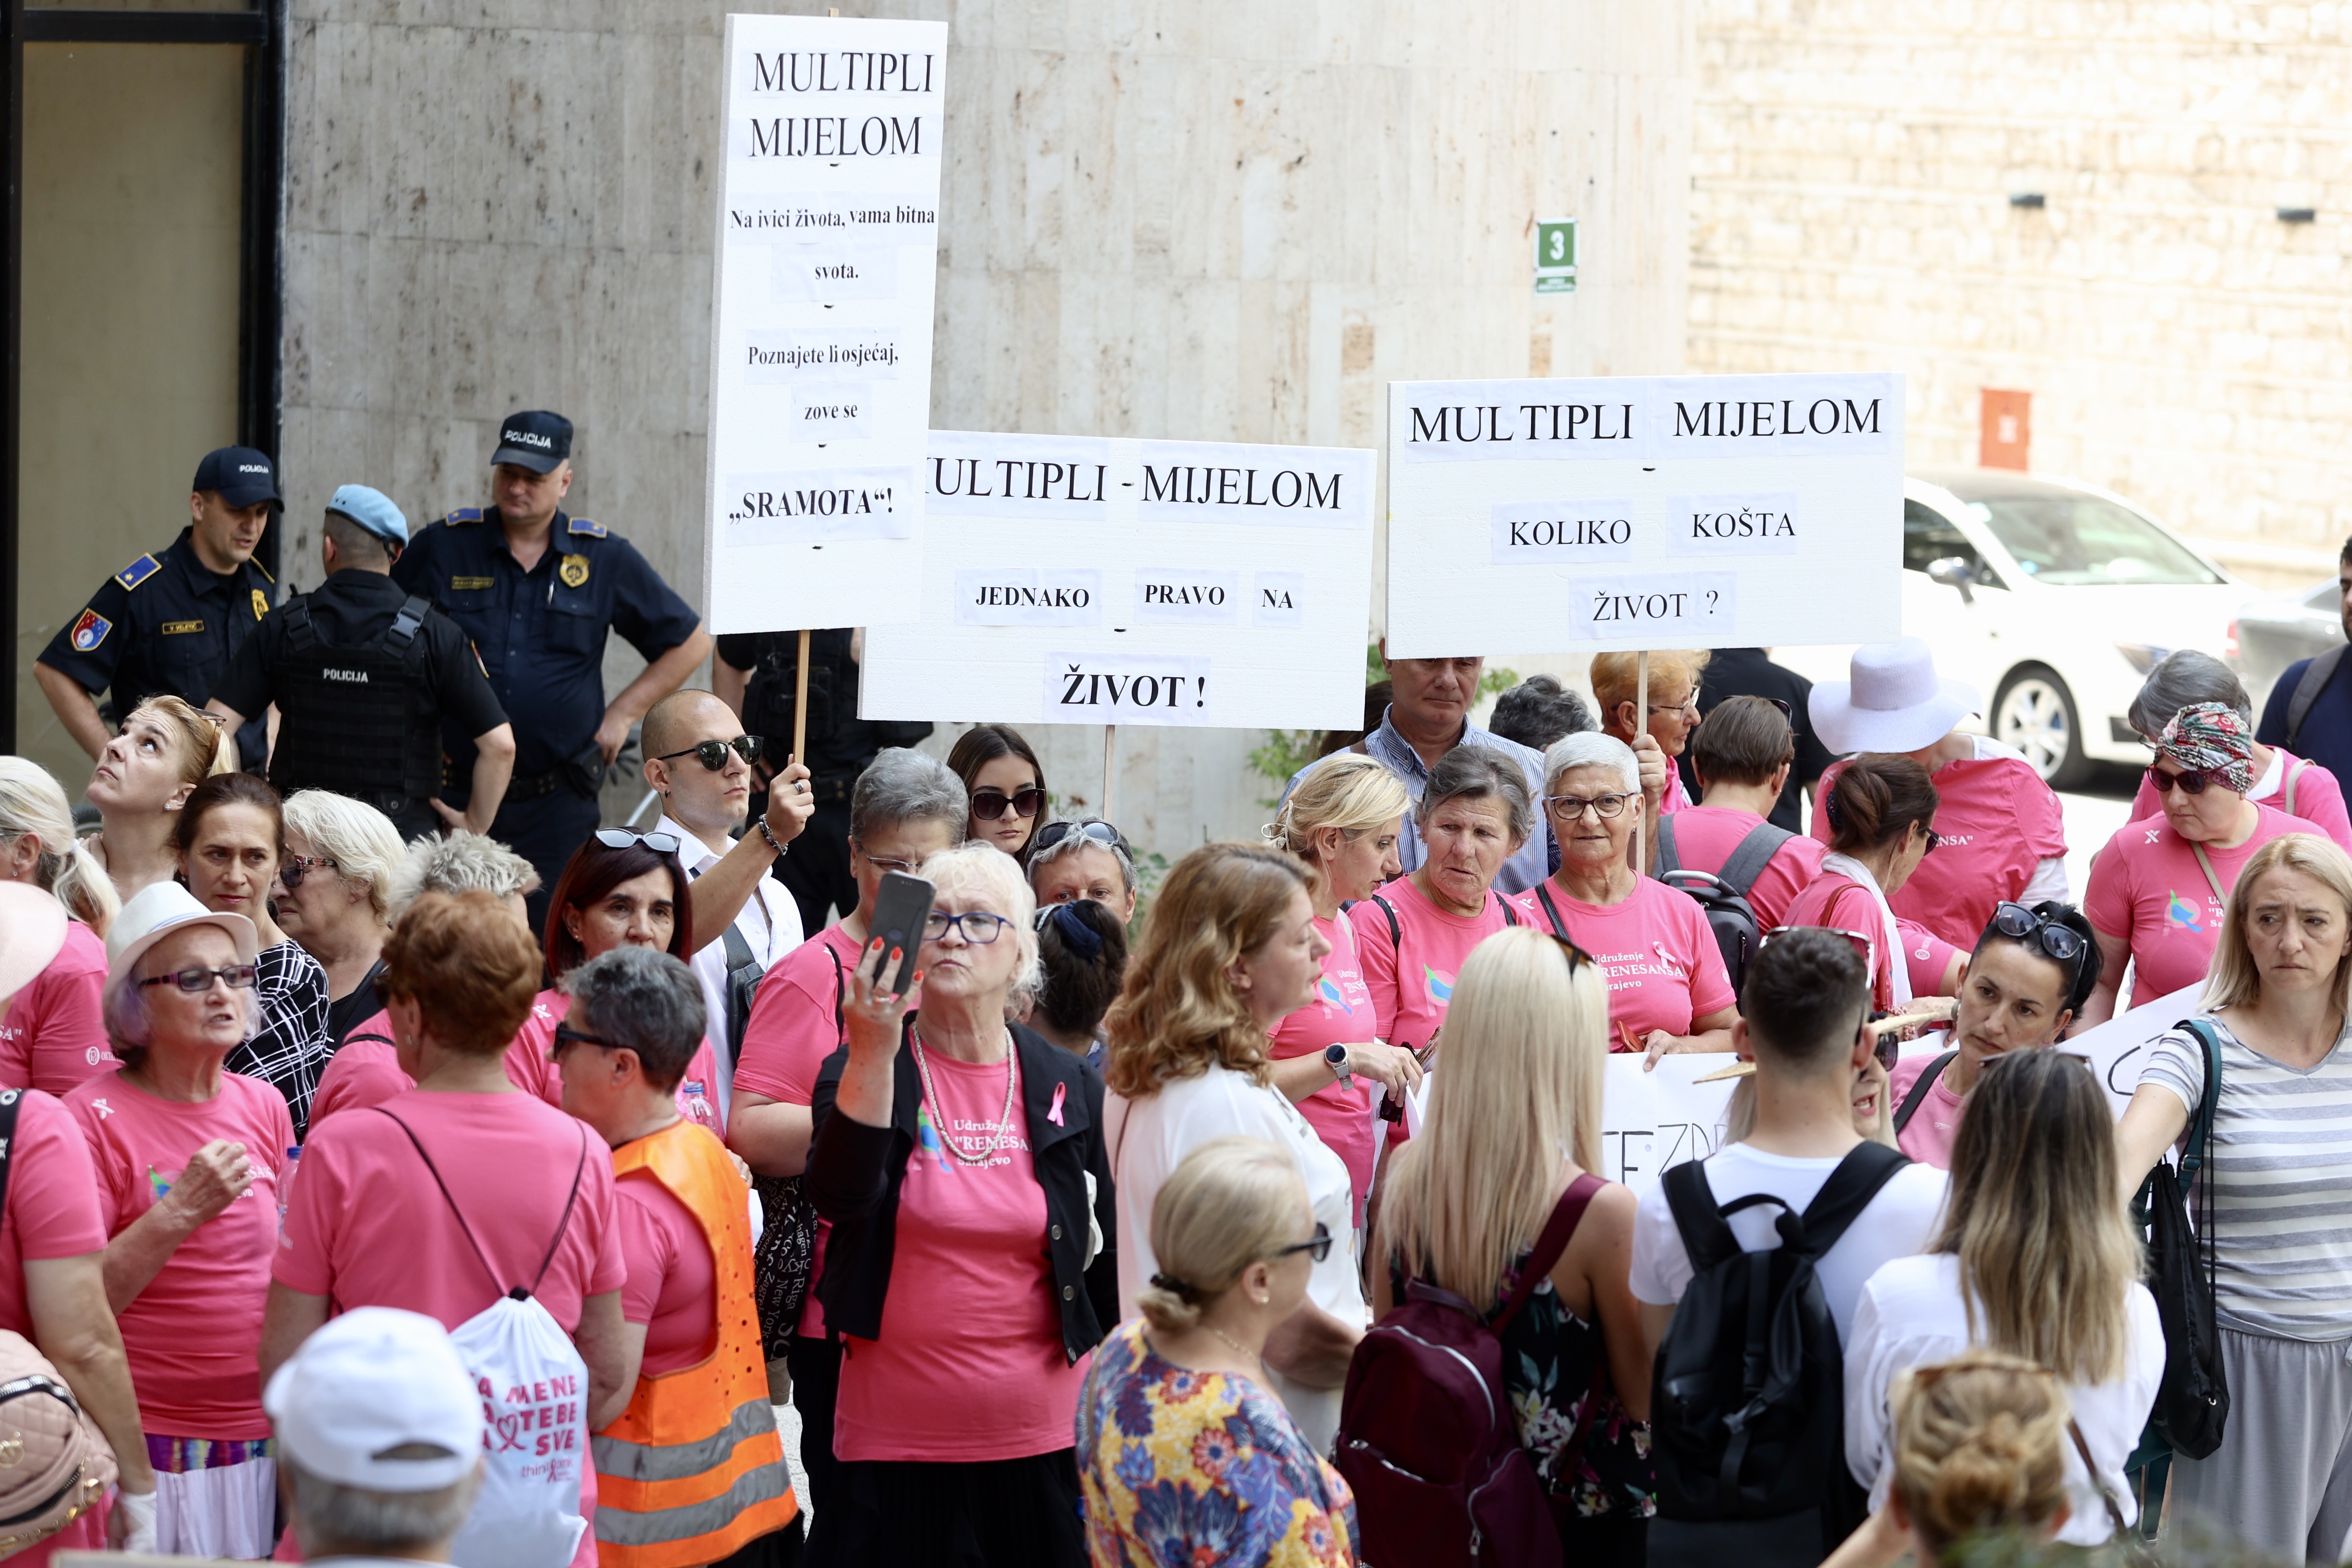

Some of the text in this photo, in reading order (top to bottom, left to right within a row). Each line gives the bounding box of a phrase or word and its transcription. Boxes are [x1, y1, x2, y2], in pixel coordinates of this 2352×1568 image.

[751, 52, 935, 92] MULTIPLI
[748, 116, 922, 157] MIJELOM
[731, 205, 935, 230] Na ivici života, vama bitna
[1550, 230, 1564, 260] 3
[815, 263, 859, 280] svota.
[748, 342, 898, 369] Poznajete li osjećaj,
[804, 404, 858, 420] zove se
[1409, 398, 1883, 443] MULTIPLI MIJELOM
[504, 429, 551, 449] POLICIJA
[1140, 465, 1344, 510] MIJELOM
[1509, 506, 1797, 546] KOLIKO KOŠTA
[975, 584, 1294, 610] JEDNAKO PRAVO NA
[1592, 590, 1719, 621] ŽIVOT ?
[324, 668, 368, 683] POLICIJA
[1060, 663, 1206, 708] ŽIVOT !
[1591, 952, 1644, 964] Udruženje
[772, 1278, 789, 1307] New
[785, 1276, 805, 1311] Riga
[505, 1376, 576, 1404] MENE
[520, 1402, 576, 1431] TEBE
[535, 1429, 575, 1457] SVE
